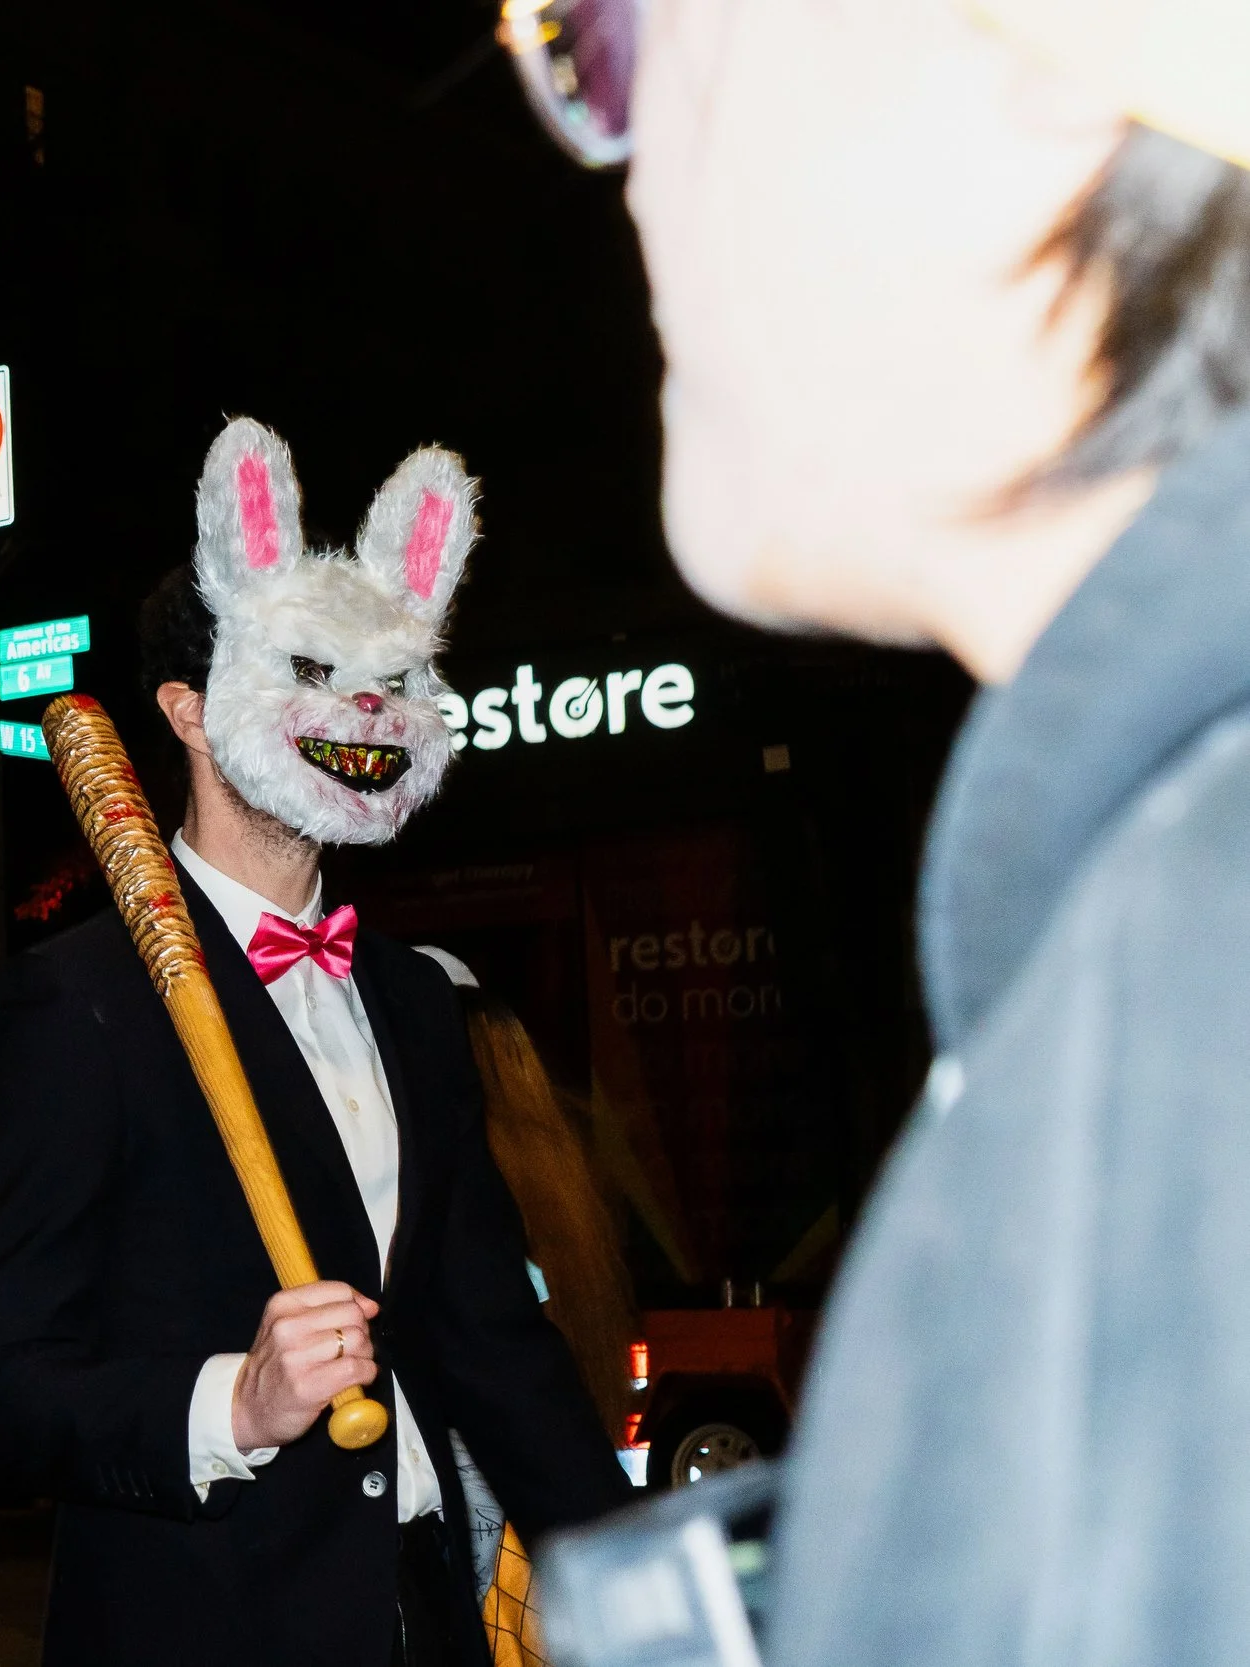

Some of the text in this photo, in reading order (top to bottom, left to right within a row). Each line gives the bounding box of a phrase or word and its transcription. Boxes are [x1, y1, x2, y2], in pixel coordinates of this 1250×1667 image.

[6, 633, 80, 661] Americas
[17, 665, 30, 692] 6
[436, 663, 695, 751] estore
[0, 724, 14, 750] W
[20, 726, 36, 753] 15
[613, 981, 669, 1023] do
